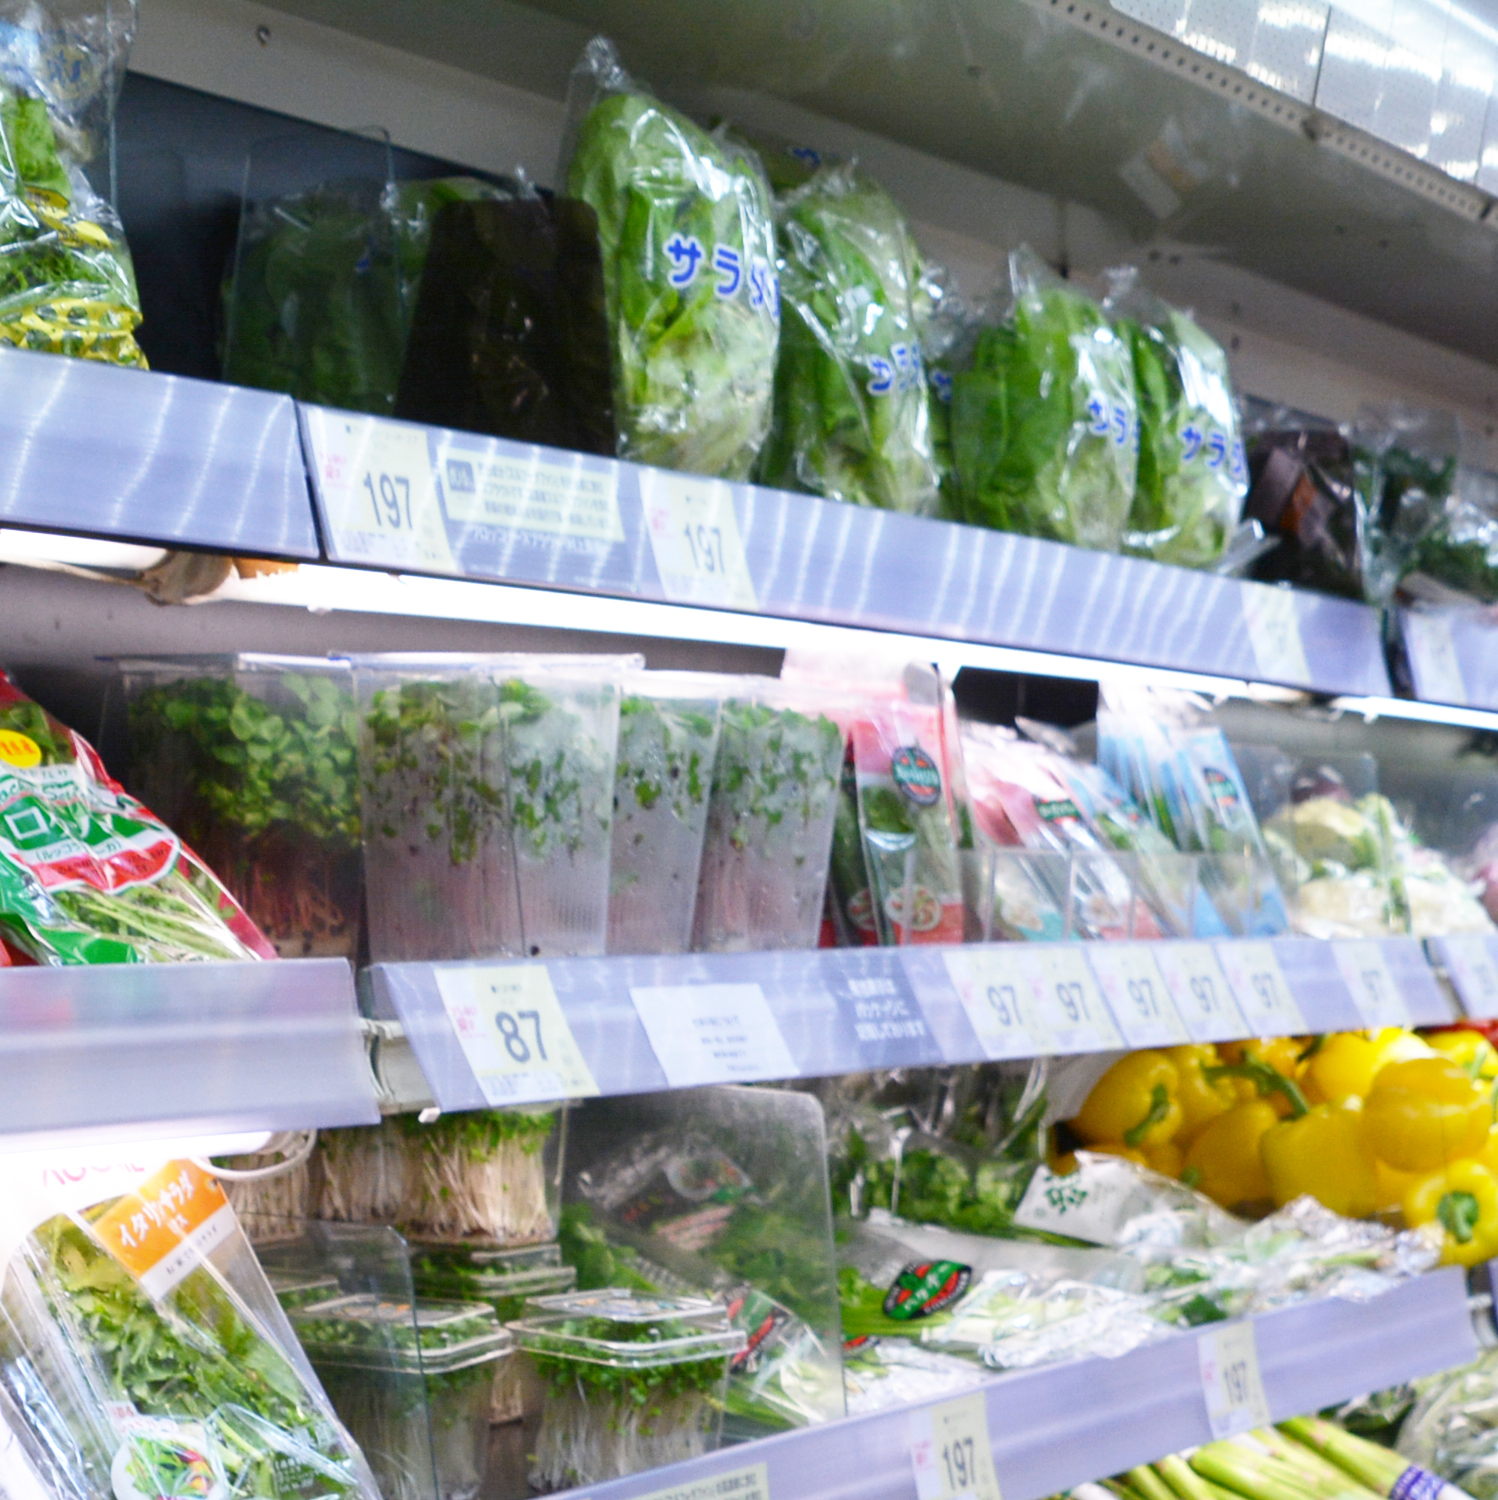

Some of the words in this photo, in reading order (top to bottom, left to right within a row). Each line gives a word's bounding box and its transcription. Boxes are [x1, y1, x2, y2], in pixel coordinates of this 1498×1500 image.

[362, 466, 415, 531] 197
[682, 521, 727, 575] 197
[986, 983, 1024, 1028] 97
[1056, 981, 1090, 1023] 97
[1127, 977, 1161, 1018] 97
[1189, 974, 1219, 1014] 97
[1251, 972, 1275, 1011] 97
[494, 1008, 548, 1064] 87
[1222, 1360, 1249, 1407] 197
[941, 1437, 978, 1493] 197
